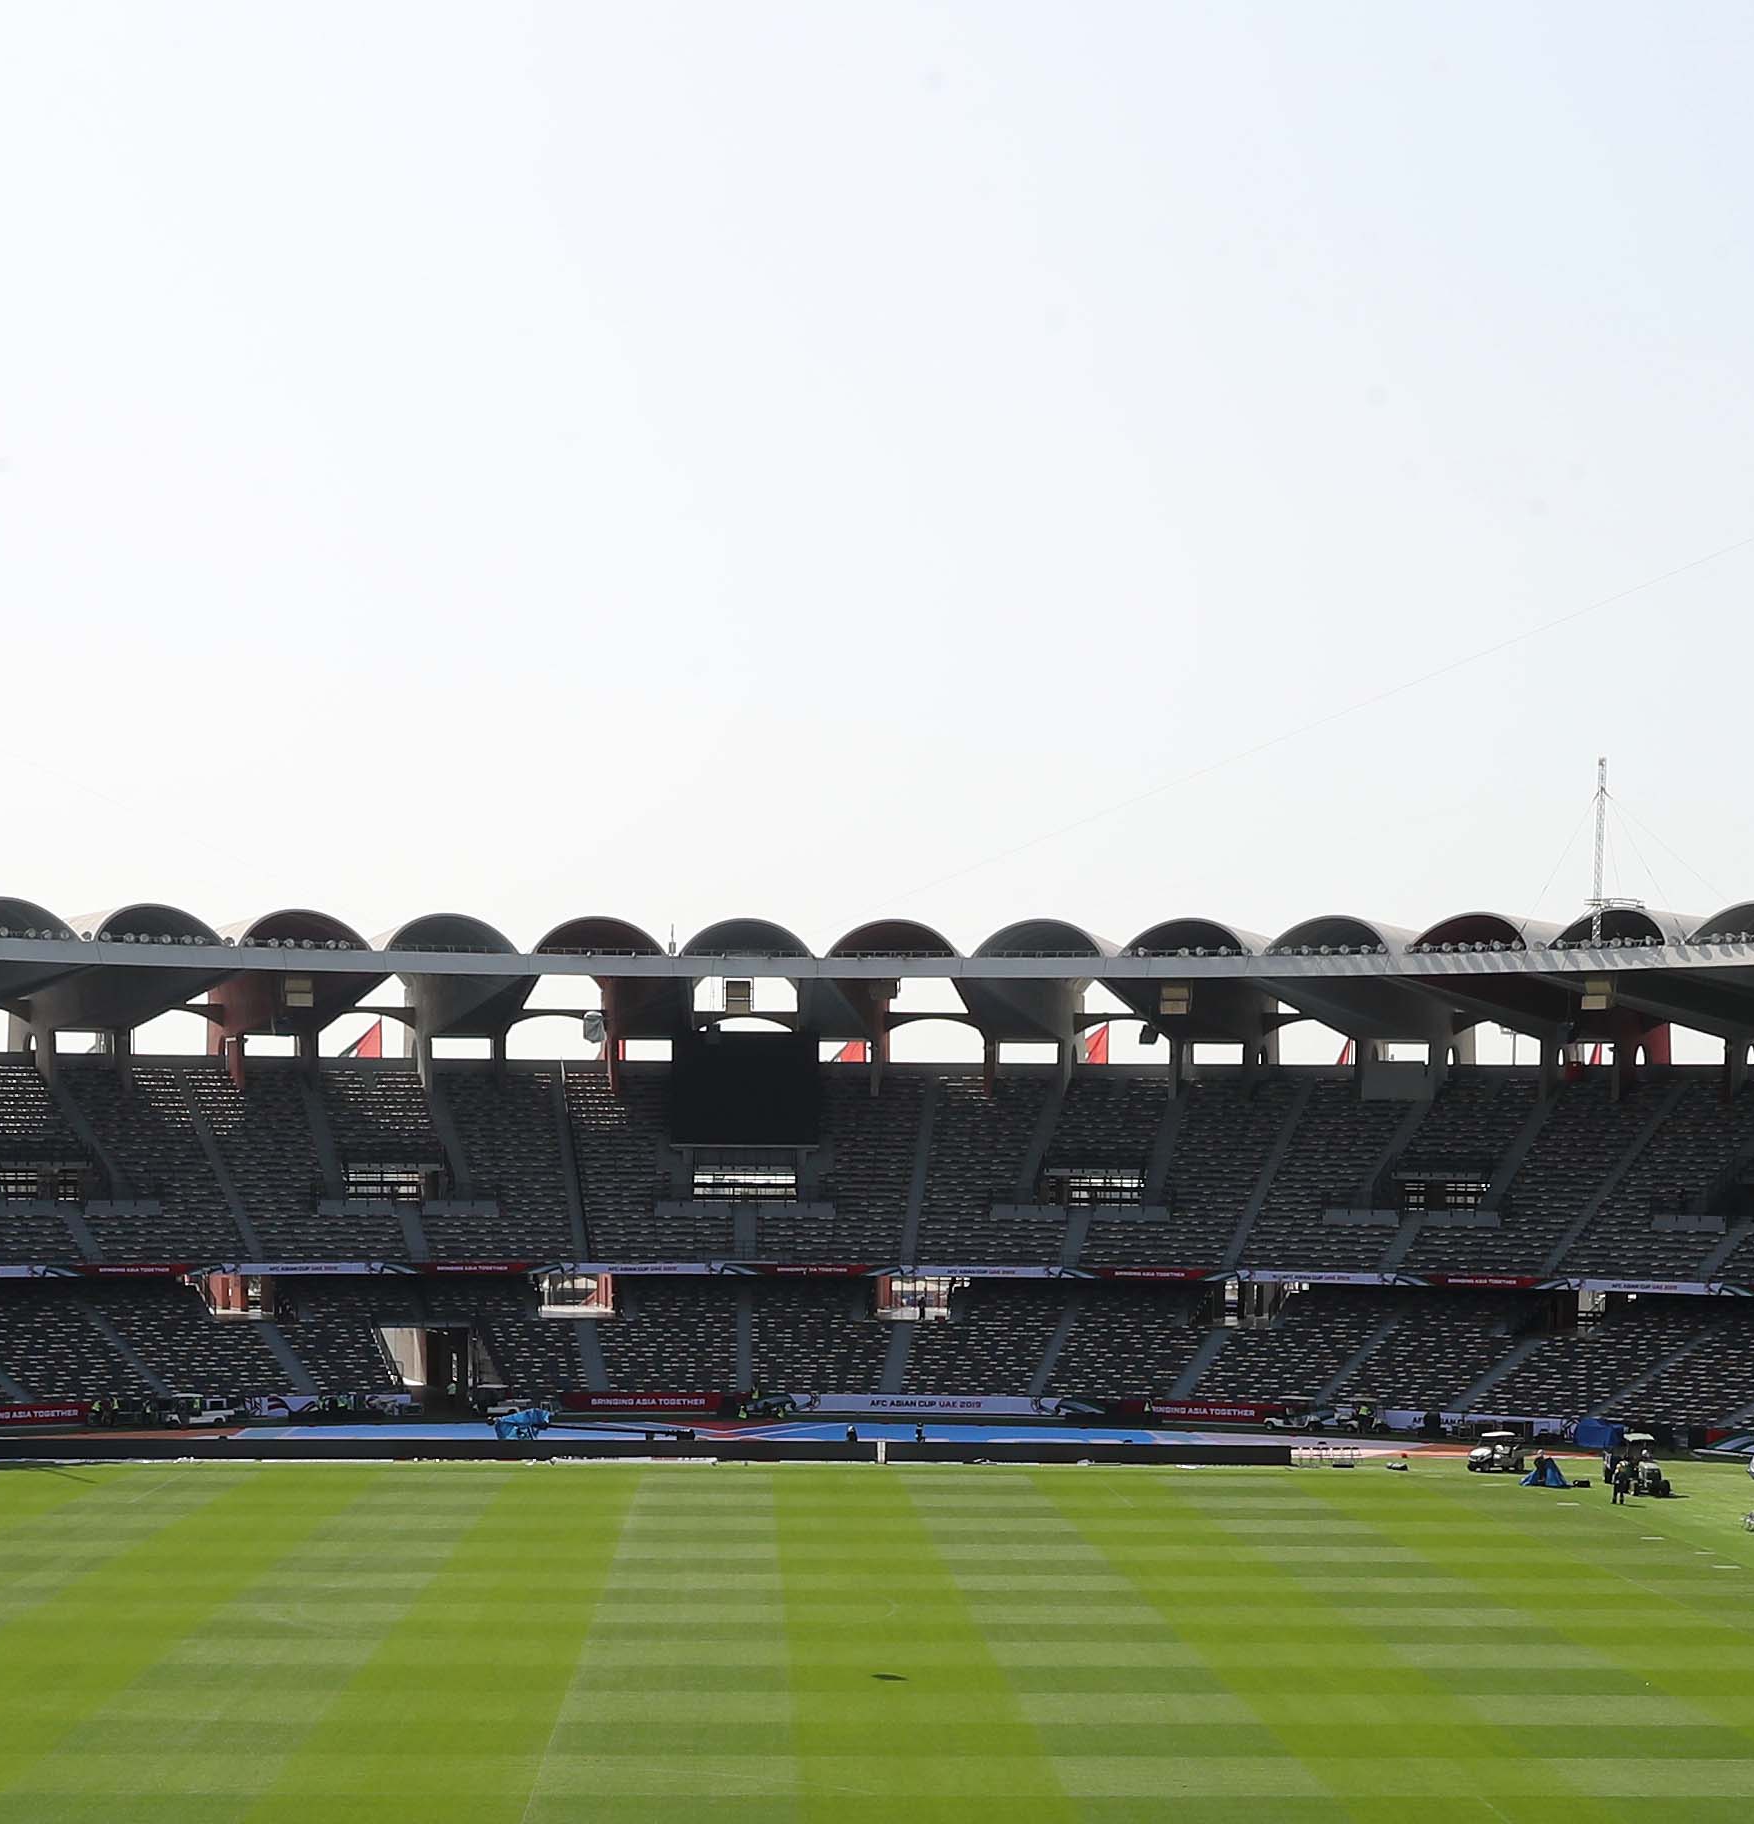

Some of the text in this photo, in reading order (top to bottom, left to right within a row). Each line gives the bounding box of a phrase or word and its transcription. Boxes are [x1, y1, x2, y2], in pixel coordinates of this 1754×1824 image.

[918, 1400, 937, 1408] CUP
[12, 1410, 32, 1419] ASIA
[34, 1409, 78, 1418] TOGETHER
[1209, 1408, 1255, 1417] TOGETHER
